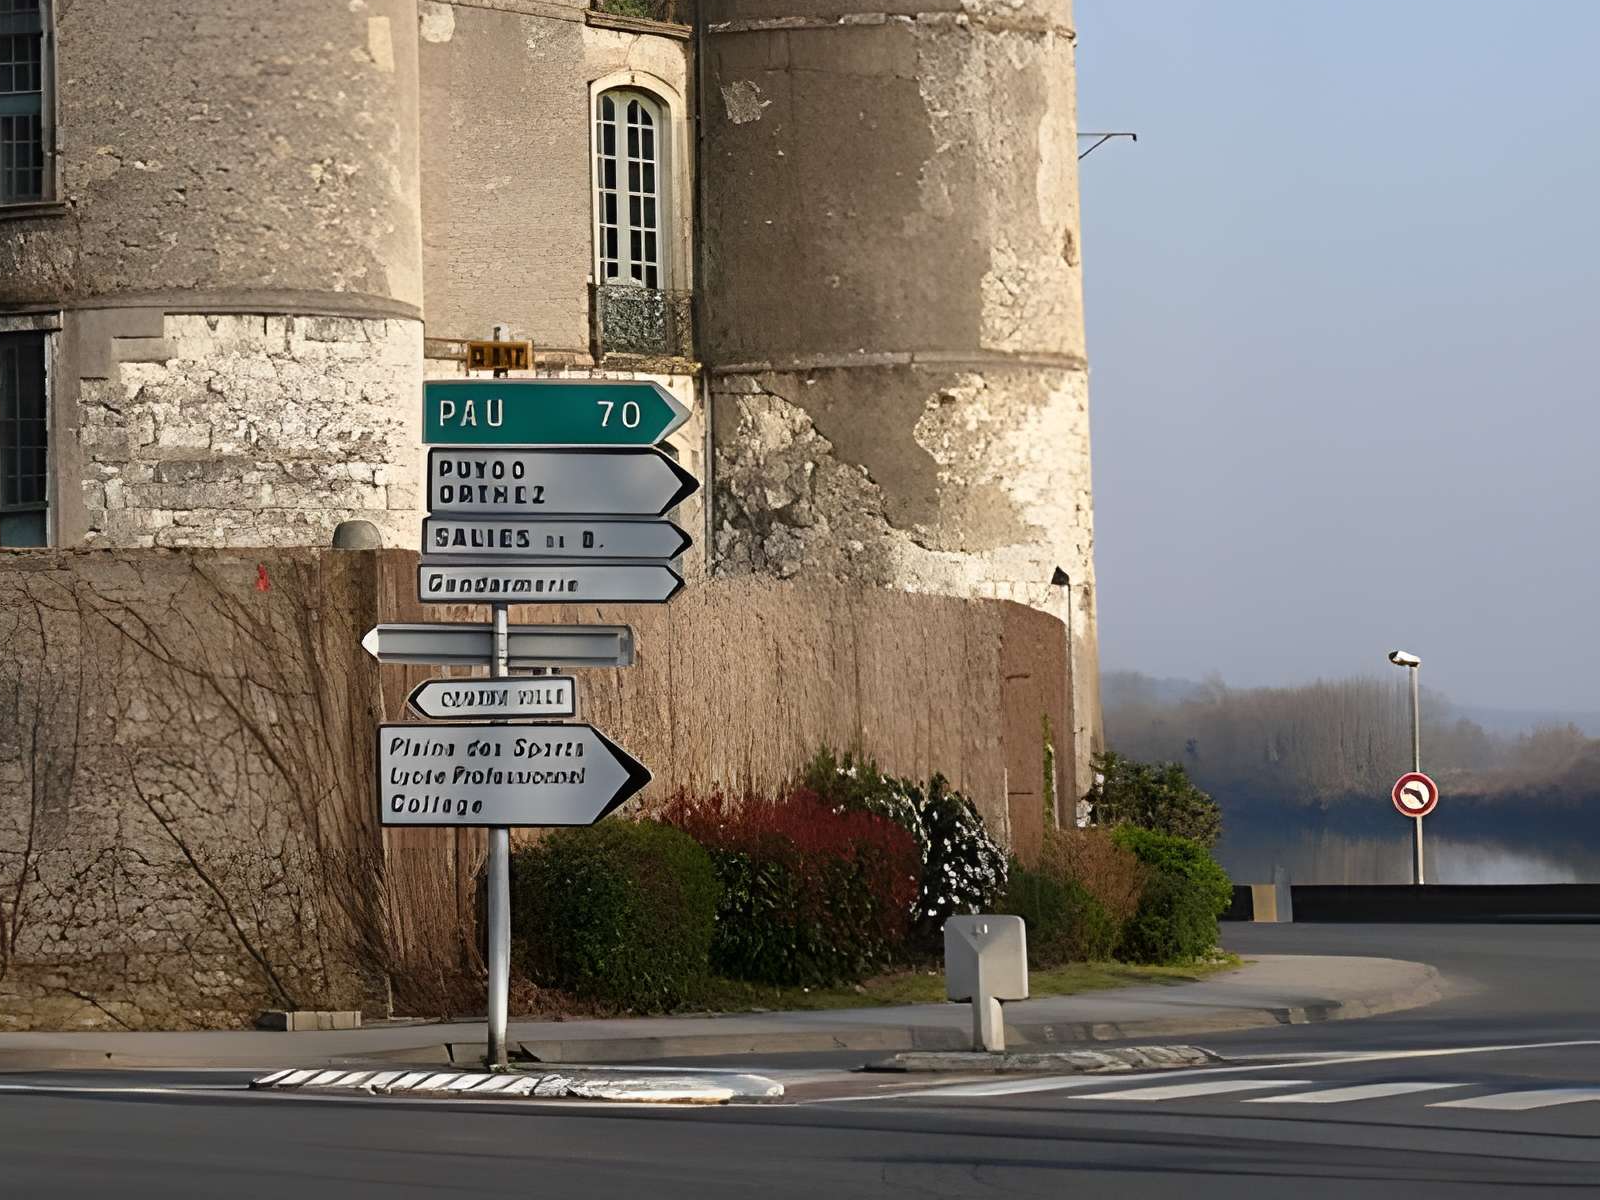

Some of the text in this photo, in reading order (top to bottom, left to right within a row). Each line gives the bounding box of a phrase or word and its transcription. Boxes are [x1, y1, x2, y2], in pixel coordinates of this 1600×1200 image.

[440, 399, 641, 428] PAU 70
[439, 460, 525, 479] PUYOO
